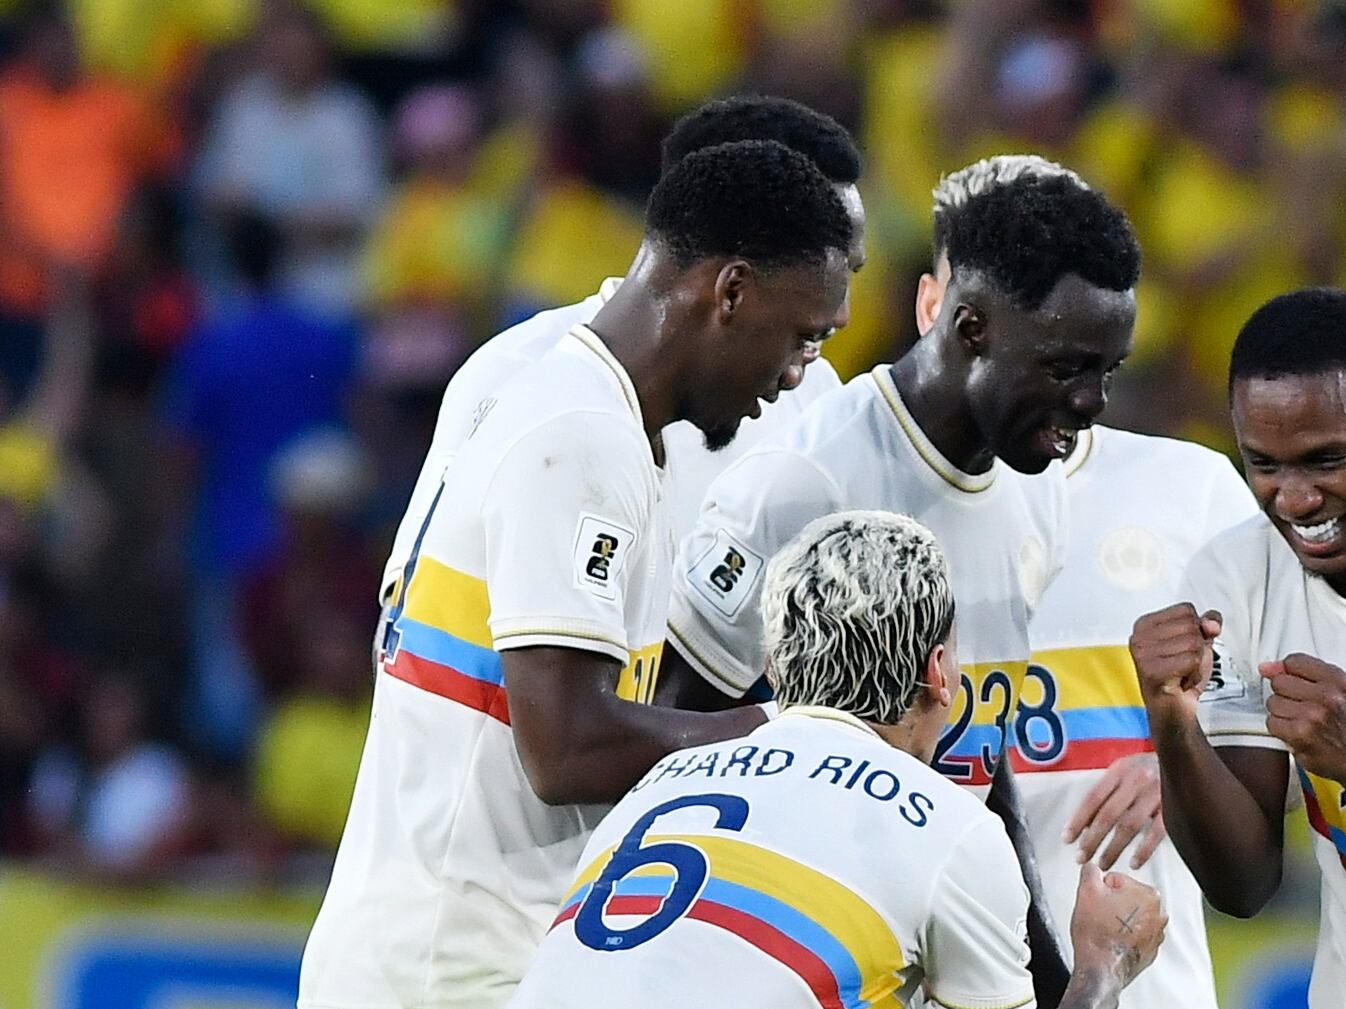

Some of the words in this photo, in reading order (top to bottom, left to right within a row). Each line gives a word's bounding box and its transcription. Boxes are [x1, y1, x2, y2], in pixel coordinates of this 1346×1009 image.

[930, 670, 1012, 778] 23
[1014, 664, 1064, 763] 8
[808, 755, 935, 828] RIOS
[574, 793, 750, 952] 6
